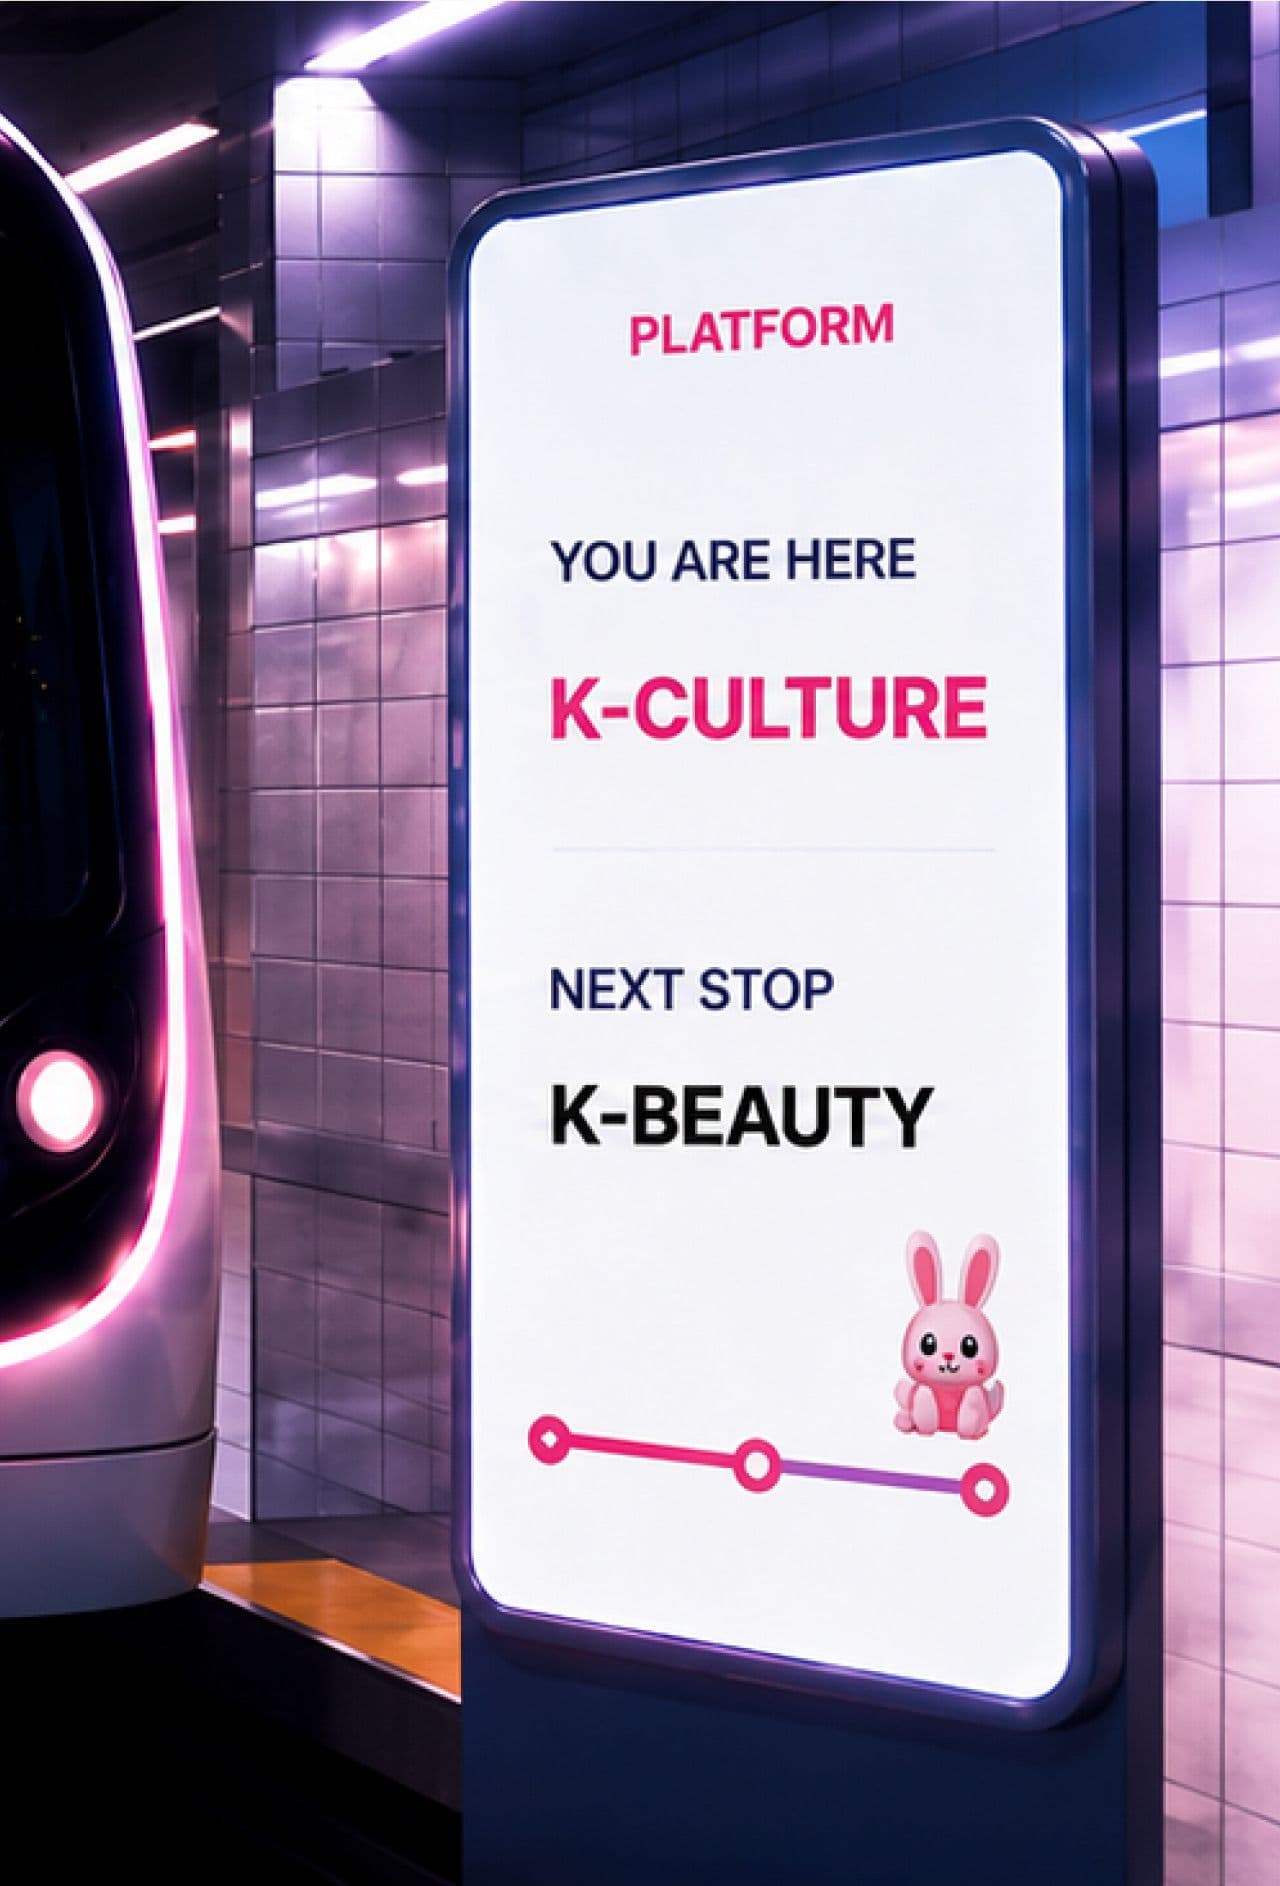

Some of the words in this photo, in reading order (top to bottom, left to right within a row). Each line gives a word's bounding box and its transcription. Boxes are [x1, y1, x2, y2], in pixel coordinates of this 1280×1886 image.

[630, 303, 894, 356] PLATFORM
[550, 539, 657, 582] YOU
[671, 539, 771, 581] ARE
[786, 537, 917, 580] HERE
[550, 675, 988, 741] K-CULTURE
[550, 967, 686, 1011] NEXT
[699, 967, 835, 1011] STOP
[552, 1084, 935, 1149] K-BEAUTY
